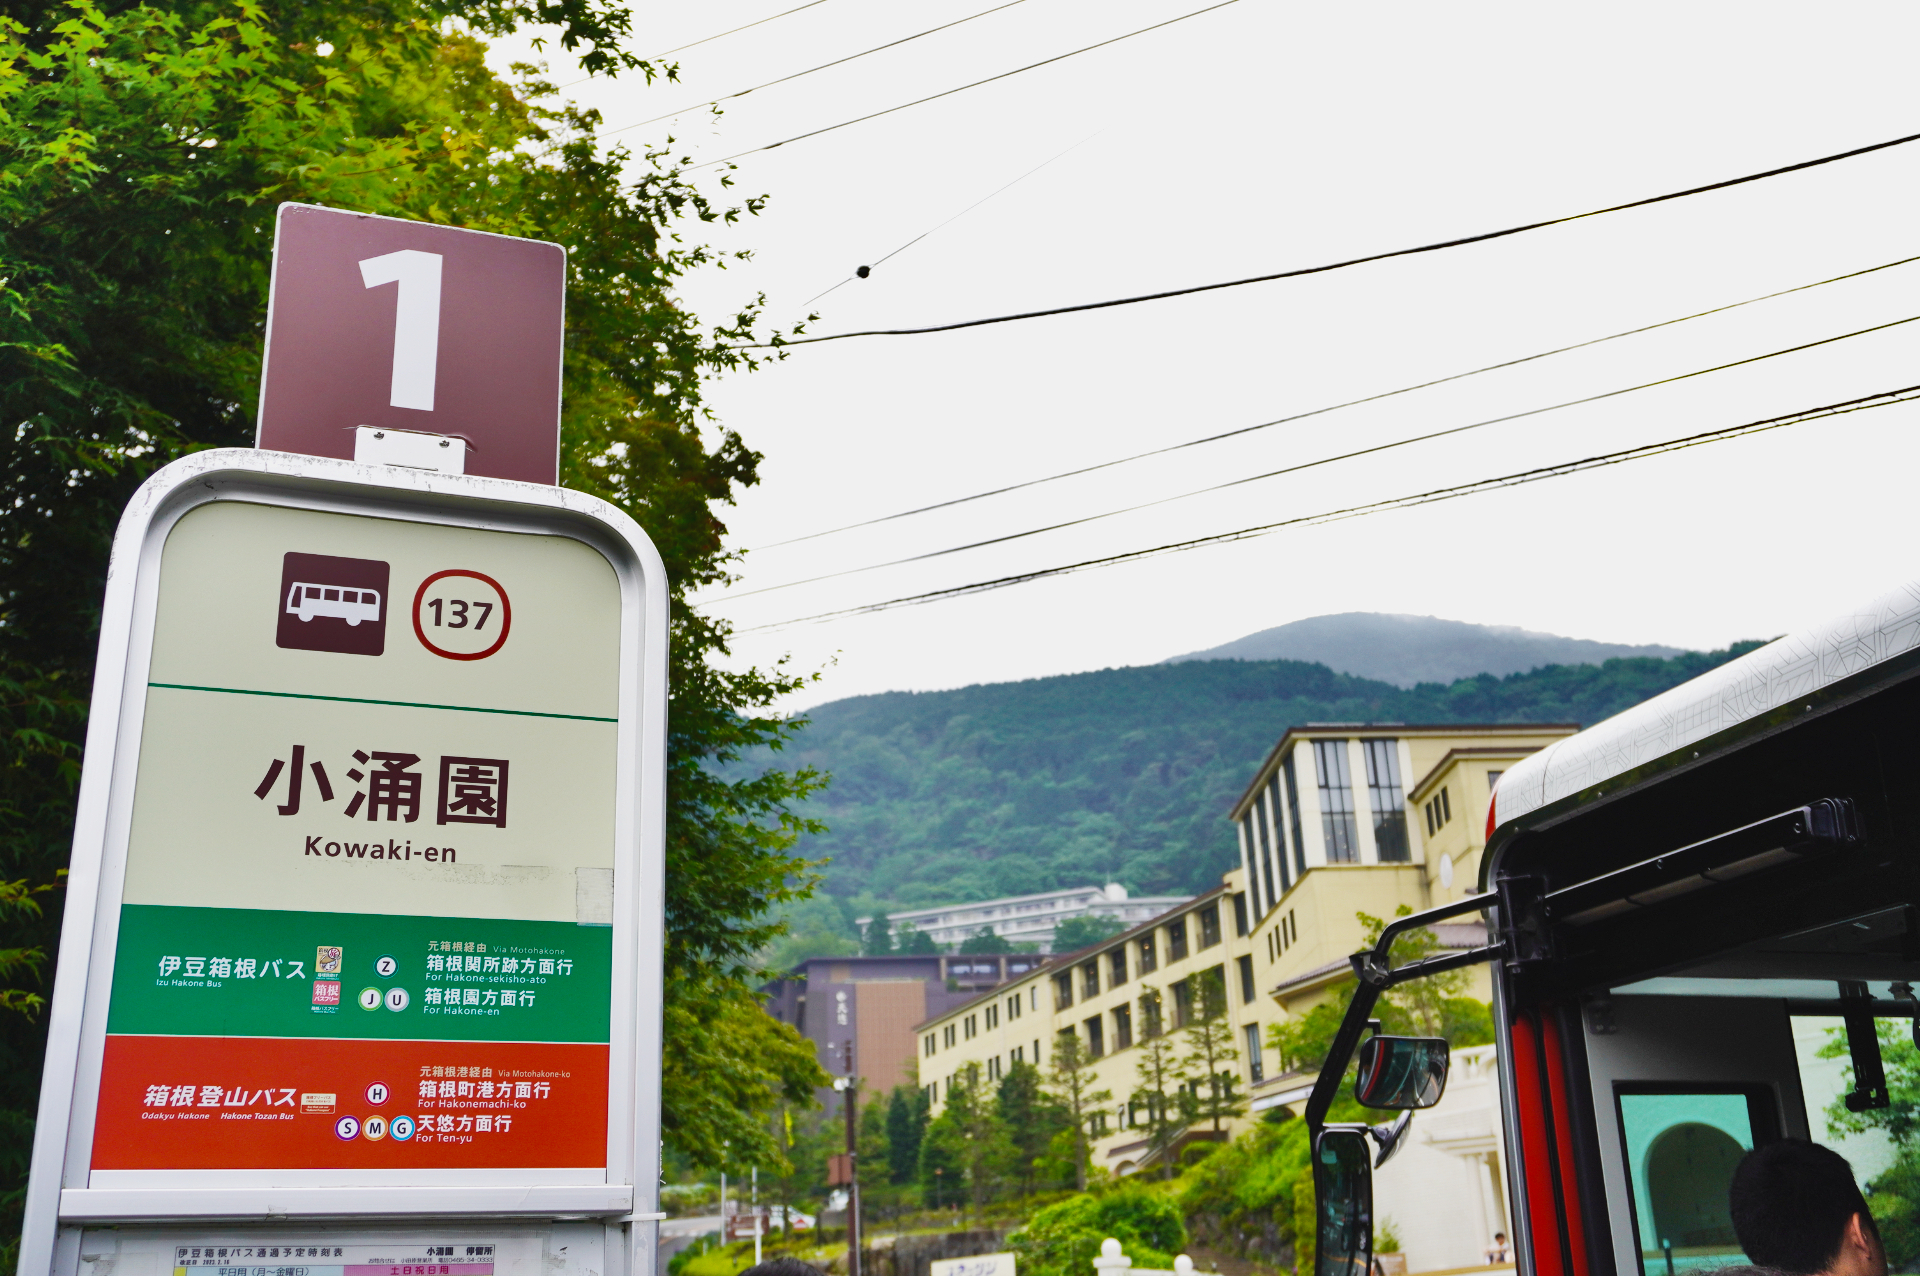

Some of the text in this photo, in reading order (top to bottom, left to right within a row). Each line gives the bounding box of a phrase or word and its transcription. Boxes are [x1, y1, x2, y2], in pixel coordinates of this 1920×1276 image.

[358, 249, 443, 411] 1
[427, 598, 493, 630] 137
[254, 744, 509, 828] 小涌園
[304, 835, 457, 863] Kowaki-en
[427, 940, 487, 953] 元箱根経由
[493, 945, 565, 955] Via Motohakone
[158, 955, 306, 980] 伊豆箱根バス
[381, 960, 391, 972] Z
[426, 954, 574, 976] 箱根関所跡方面行
[171, 979, 204, 988] Hakone
[206, 980, 222, 988] Bus
[425, 973, 547, 984] For Hakone-sekisho-ato
[392, 994, 402, 1006] U
[424, 987, 536, 1008] 箱根園方面行
[423, 1006, 500, 1016] For Hakone-en
[419, 1065, 493, 1078] 元箱根港経由
[498, 1069, 571, 1078] Via Motohakone-ko
[372, 1088, 382, 1100] H
[418, 1080, 551, 1099] 箱根町港方面行
[143, 1085, 297, 1107] 箱根登山バス
[418, 1099, 527, 1109] For Hakonemachi-ko
[141, 1111, 210, 1121] Odakyu Hakone
[220, 1112, 294, 1120] Hakone Tozan Bus
[343, 1122, 407, 1134] S M G
[416, 1114, 512, 1133] 天悠方面行
[416, 1133, 473, 1144] For Ten-yu
